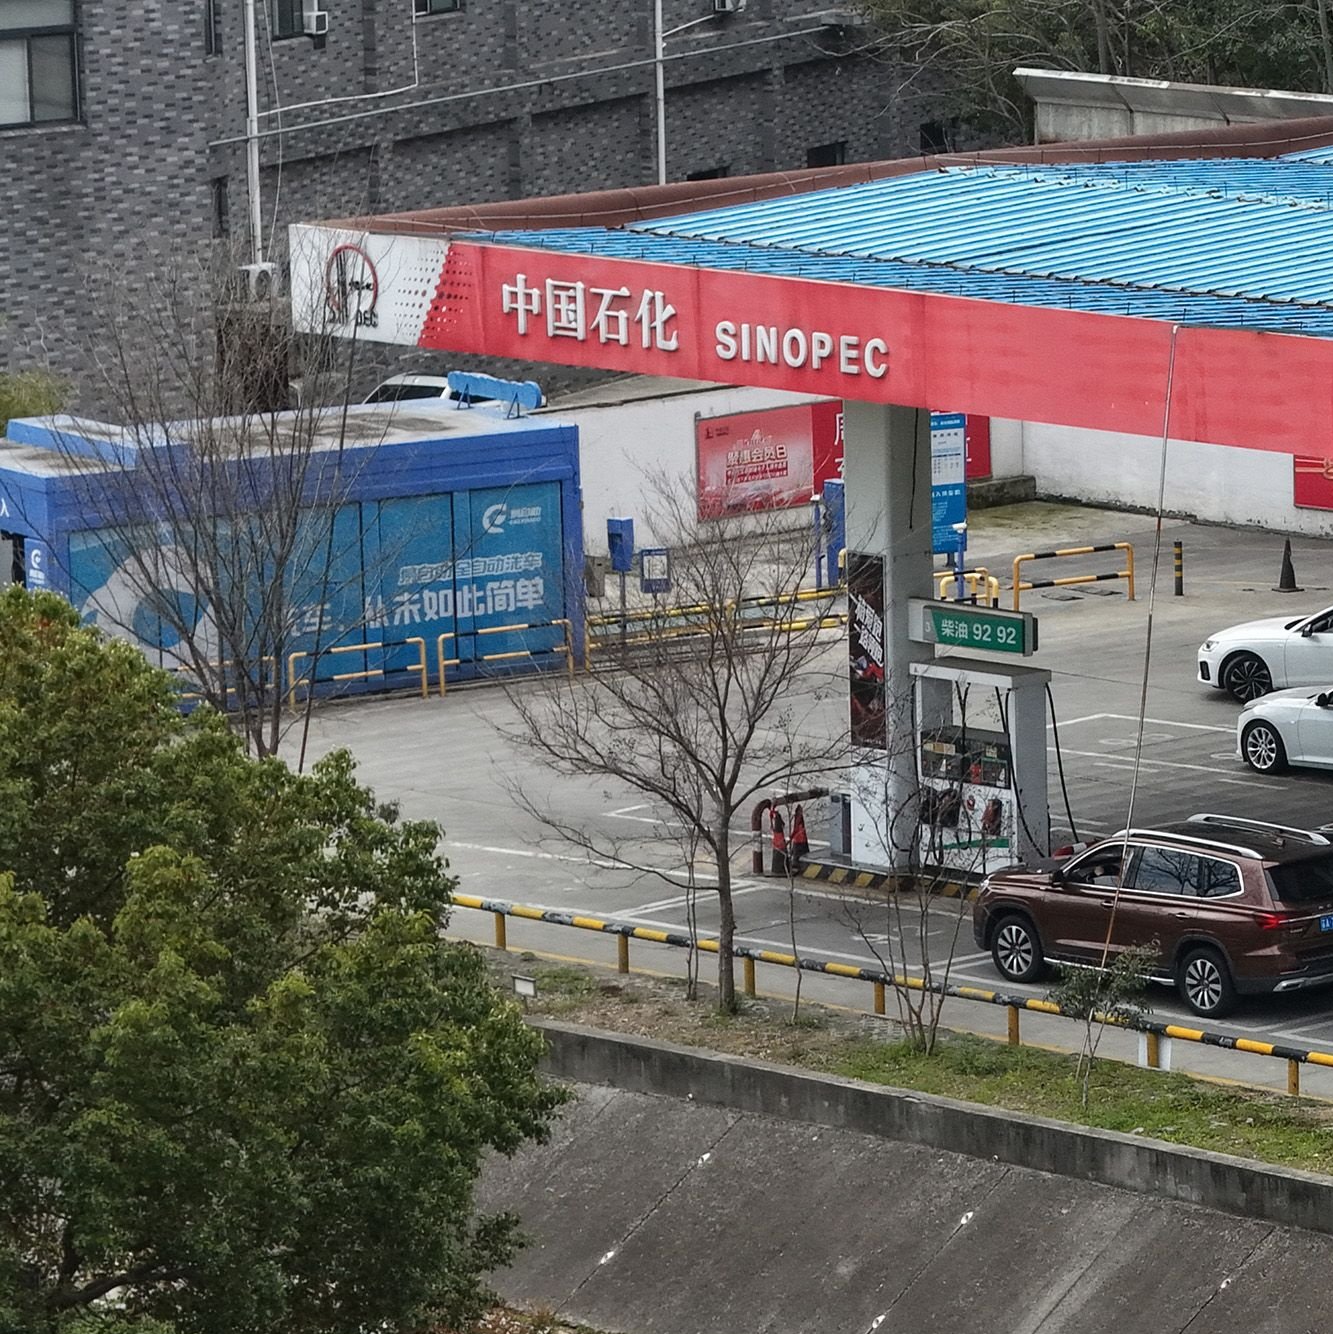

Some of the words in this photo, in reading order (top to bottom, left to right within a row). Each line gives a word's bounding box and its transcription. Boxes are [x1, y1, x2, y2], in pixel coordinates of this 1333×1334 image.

[502, 273, 679, 351] 中国石化
[715, 320, 889, 378] SINOPEC
[941, 618, 968, 640] 柴油
[973, 624, 992, 642] 92
[997, 626, 1016, 645] 92
